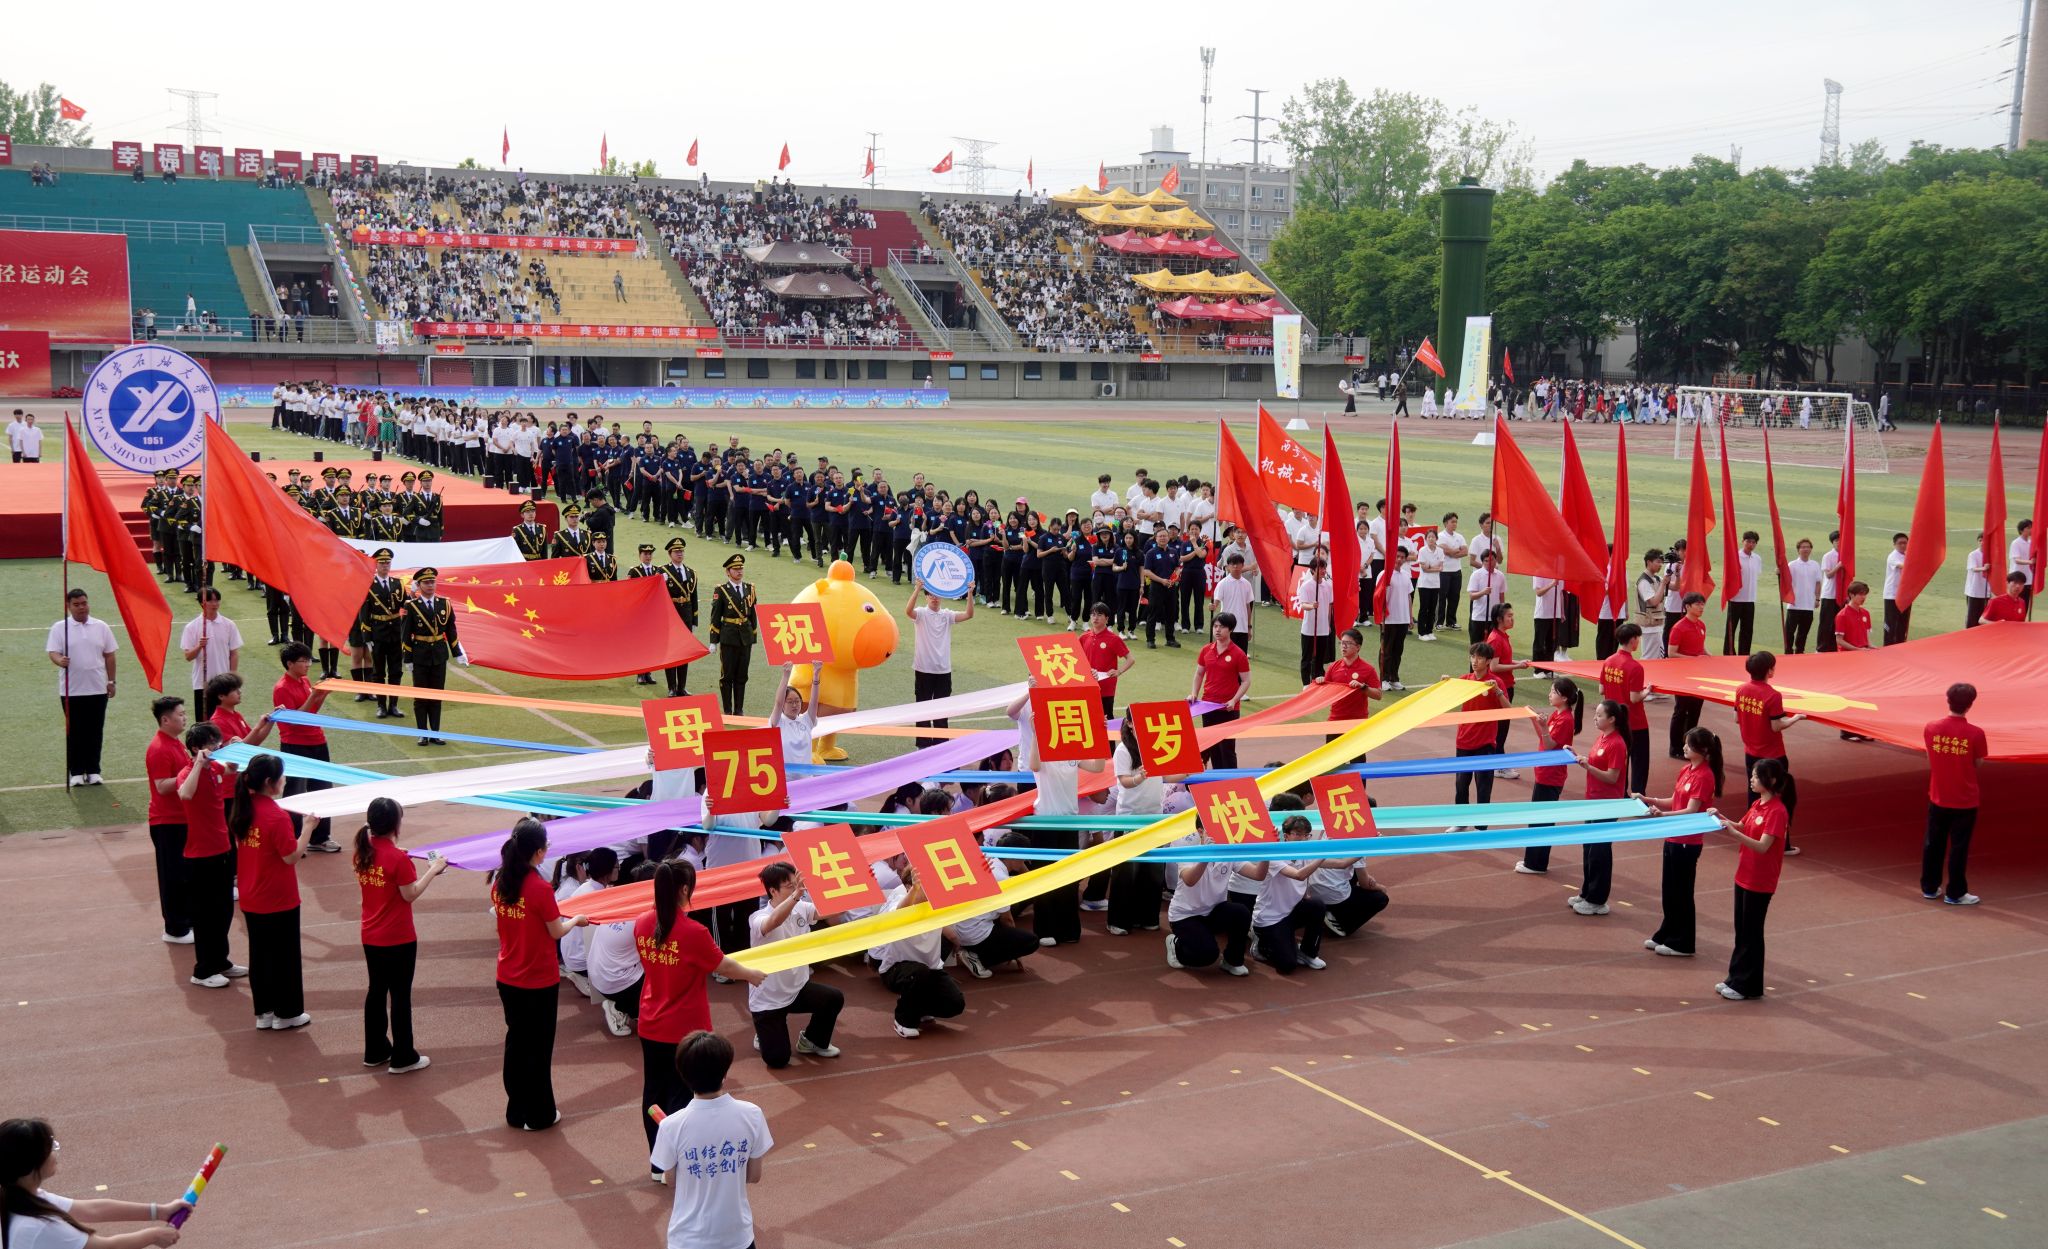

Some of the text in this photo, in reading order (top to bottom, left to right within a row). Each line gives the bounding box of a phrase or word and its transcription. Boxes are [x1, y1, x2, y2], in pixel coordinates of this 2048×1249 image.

[111, 442, 157, 465] SHIYOU
[163, 423, 203, 464] UNIVERS
[143, 436, 163, 445] 1951
[770, 613, 822, 655] 祝
[1034, 643, 1086, 686] 校
[659, 707, 713, 757] 母
[1047, 699, 1095, 750] 周
[1145, 713, 1182, 766] 岁
[713, 748, 778, 799] 75
[1209, 790, 1265, 845] 快
[1327, 784, 1366, 832] 乐
[808, 841, 869, 900] 生
[924, 838, 978, 892] 日
[685, 1138, 748, 1161] 团结奋进
